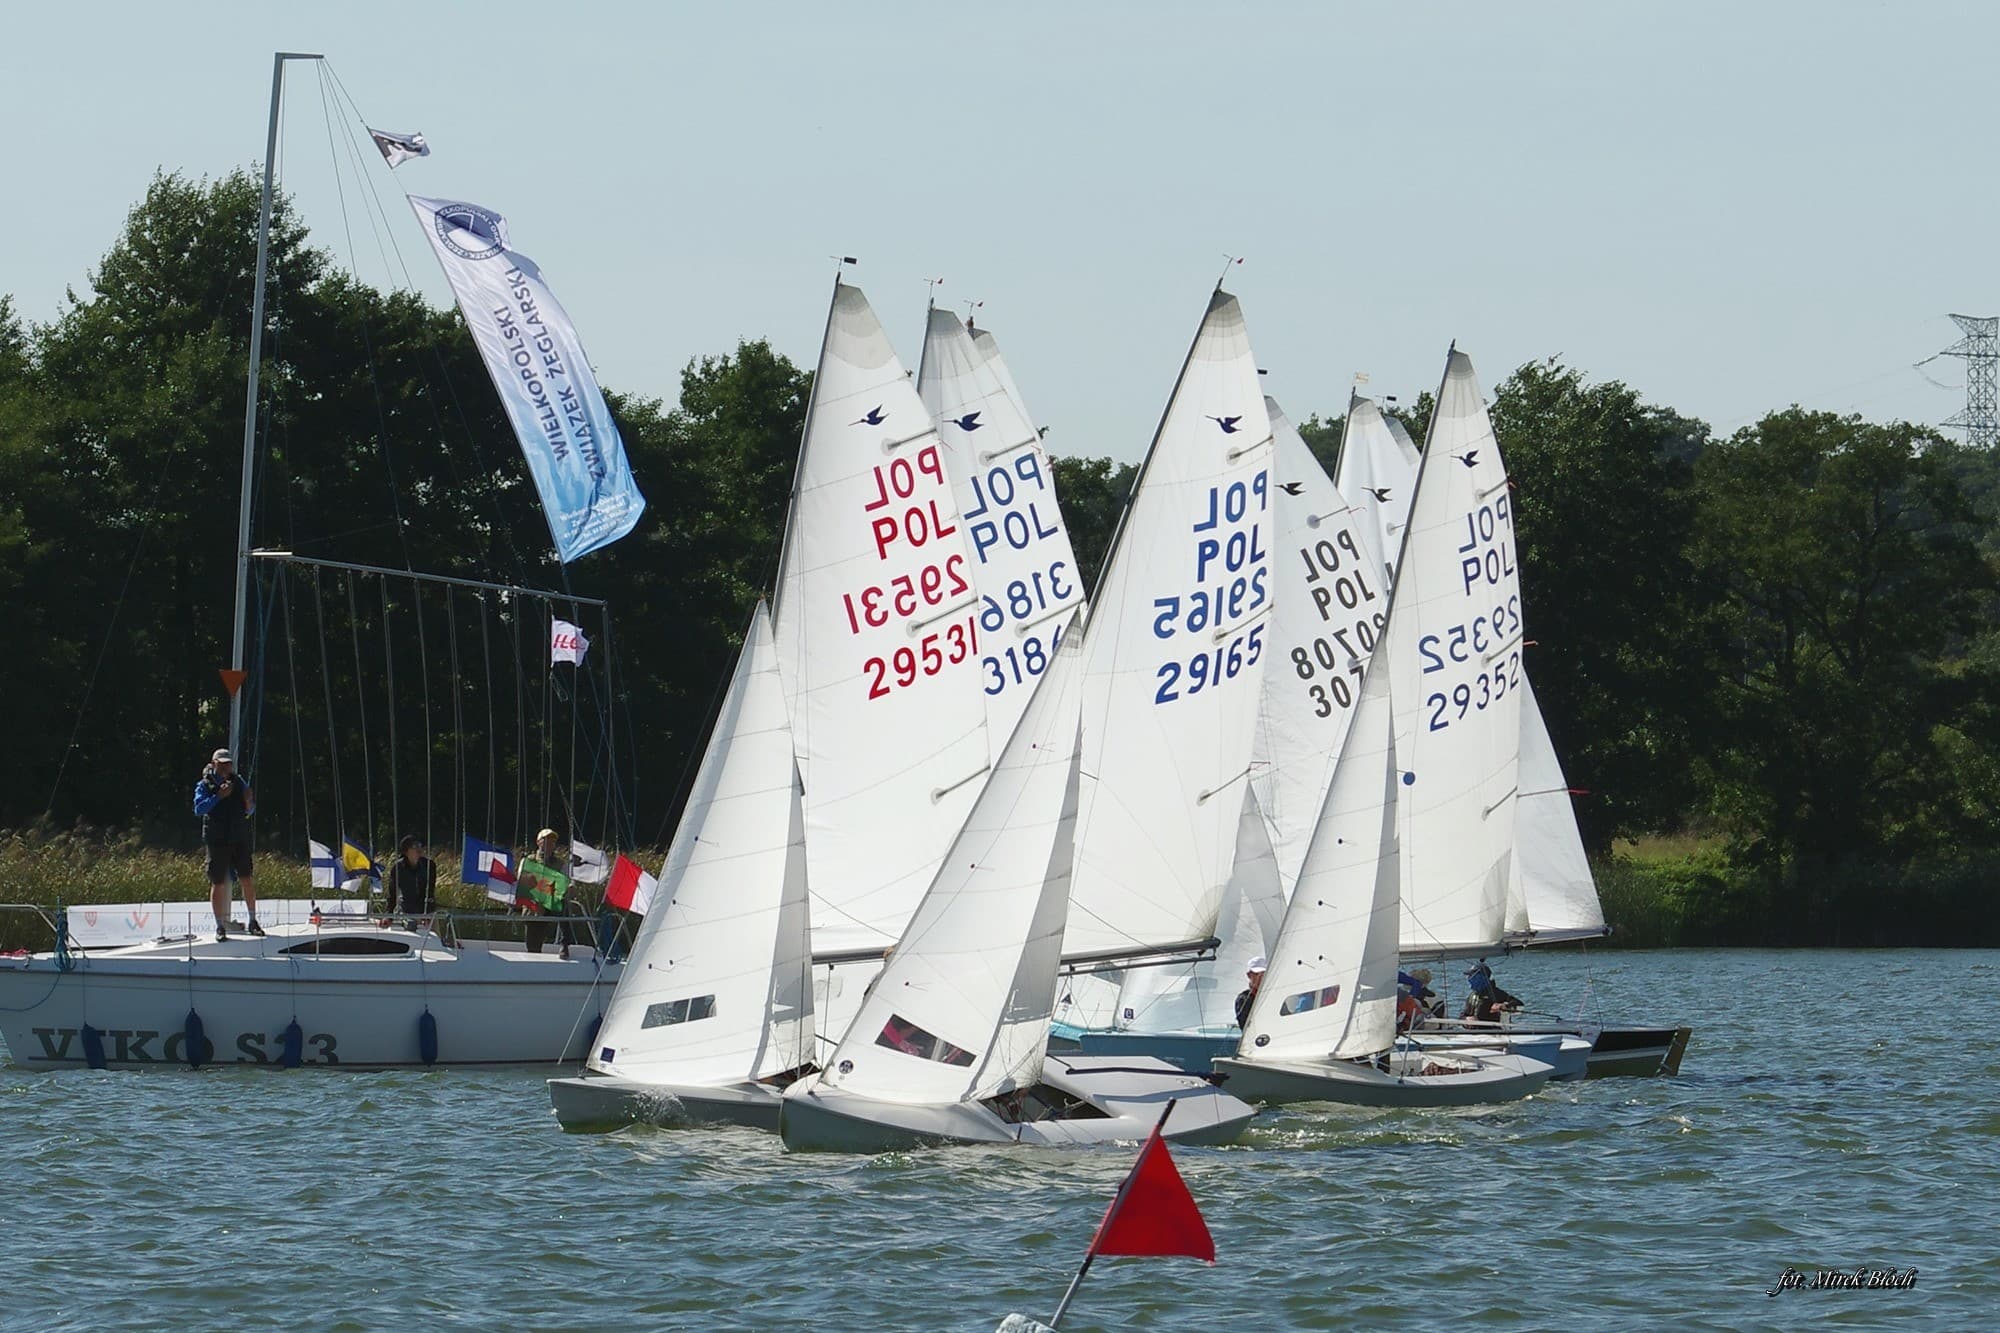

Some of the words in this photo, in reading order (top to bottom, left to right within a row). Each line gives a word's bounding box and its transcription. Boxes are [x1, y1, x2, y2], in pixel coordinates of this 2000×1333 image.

[505, 266, 565, 379] ŻEGLARSKI
[494, 306, 570, 461] WIELKOPOLSKI
[557, 385, 606, 481] ZWIĄZEK
[872, 500, 956, 560] POL
[970, 503, 1058, 563] POL
[1197, 524, 1266, 583] POL
[1311, 569, 1376, 621] POL
[1462, 542, 1514, 596] POL
[863, 616, 978, 700] 29531
[1155, 623, 1265, 704] 29165
[1427, 651, 1519, 732] 29352
[32, 1028, 214, 1063] VKO
